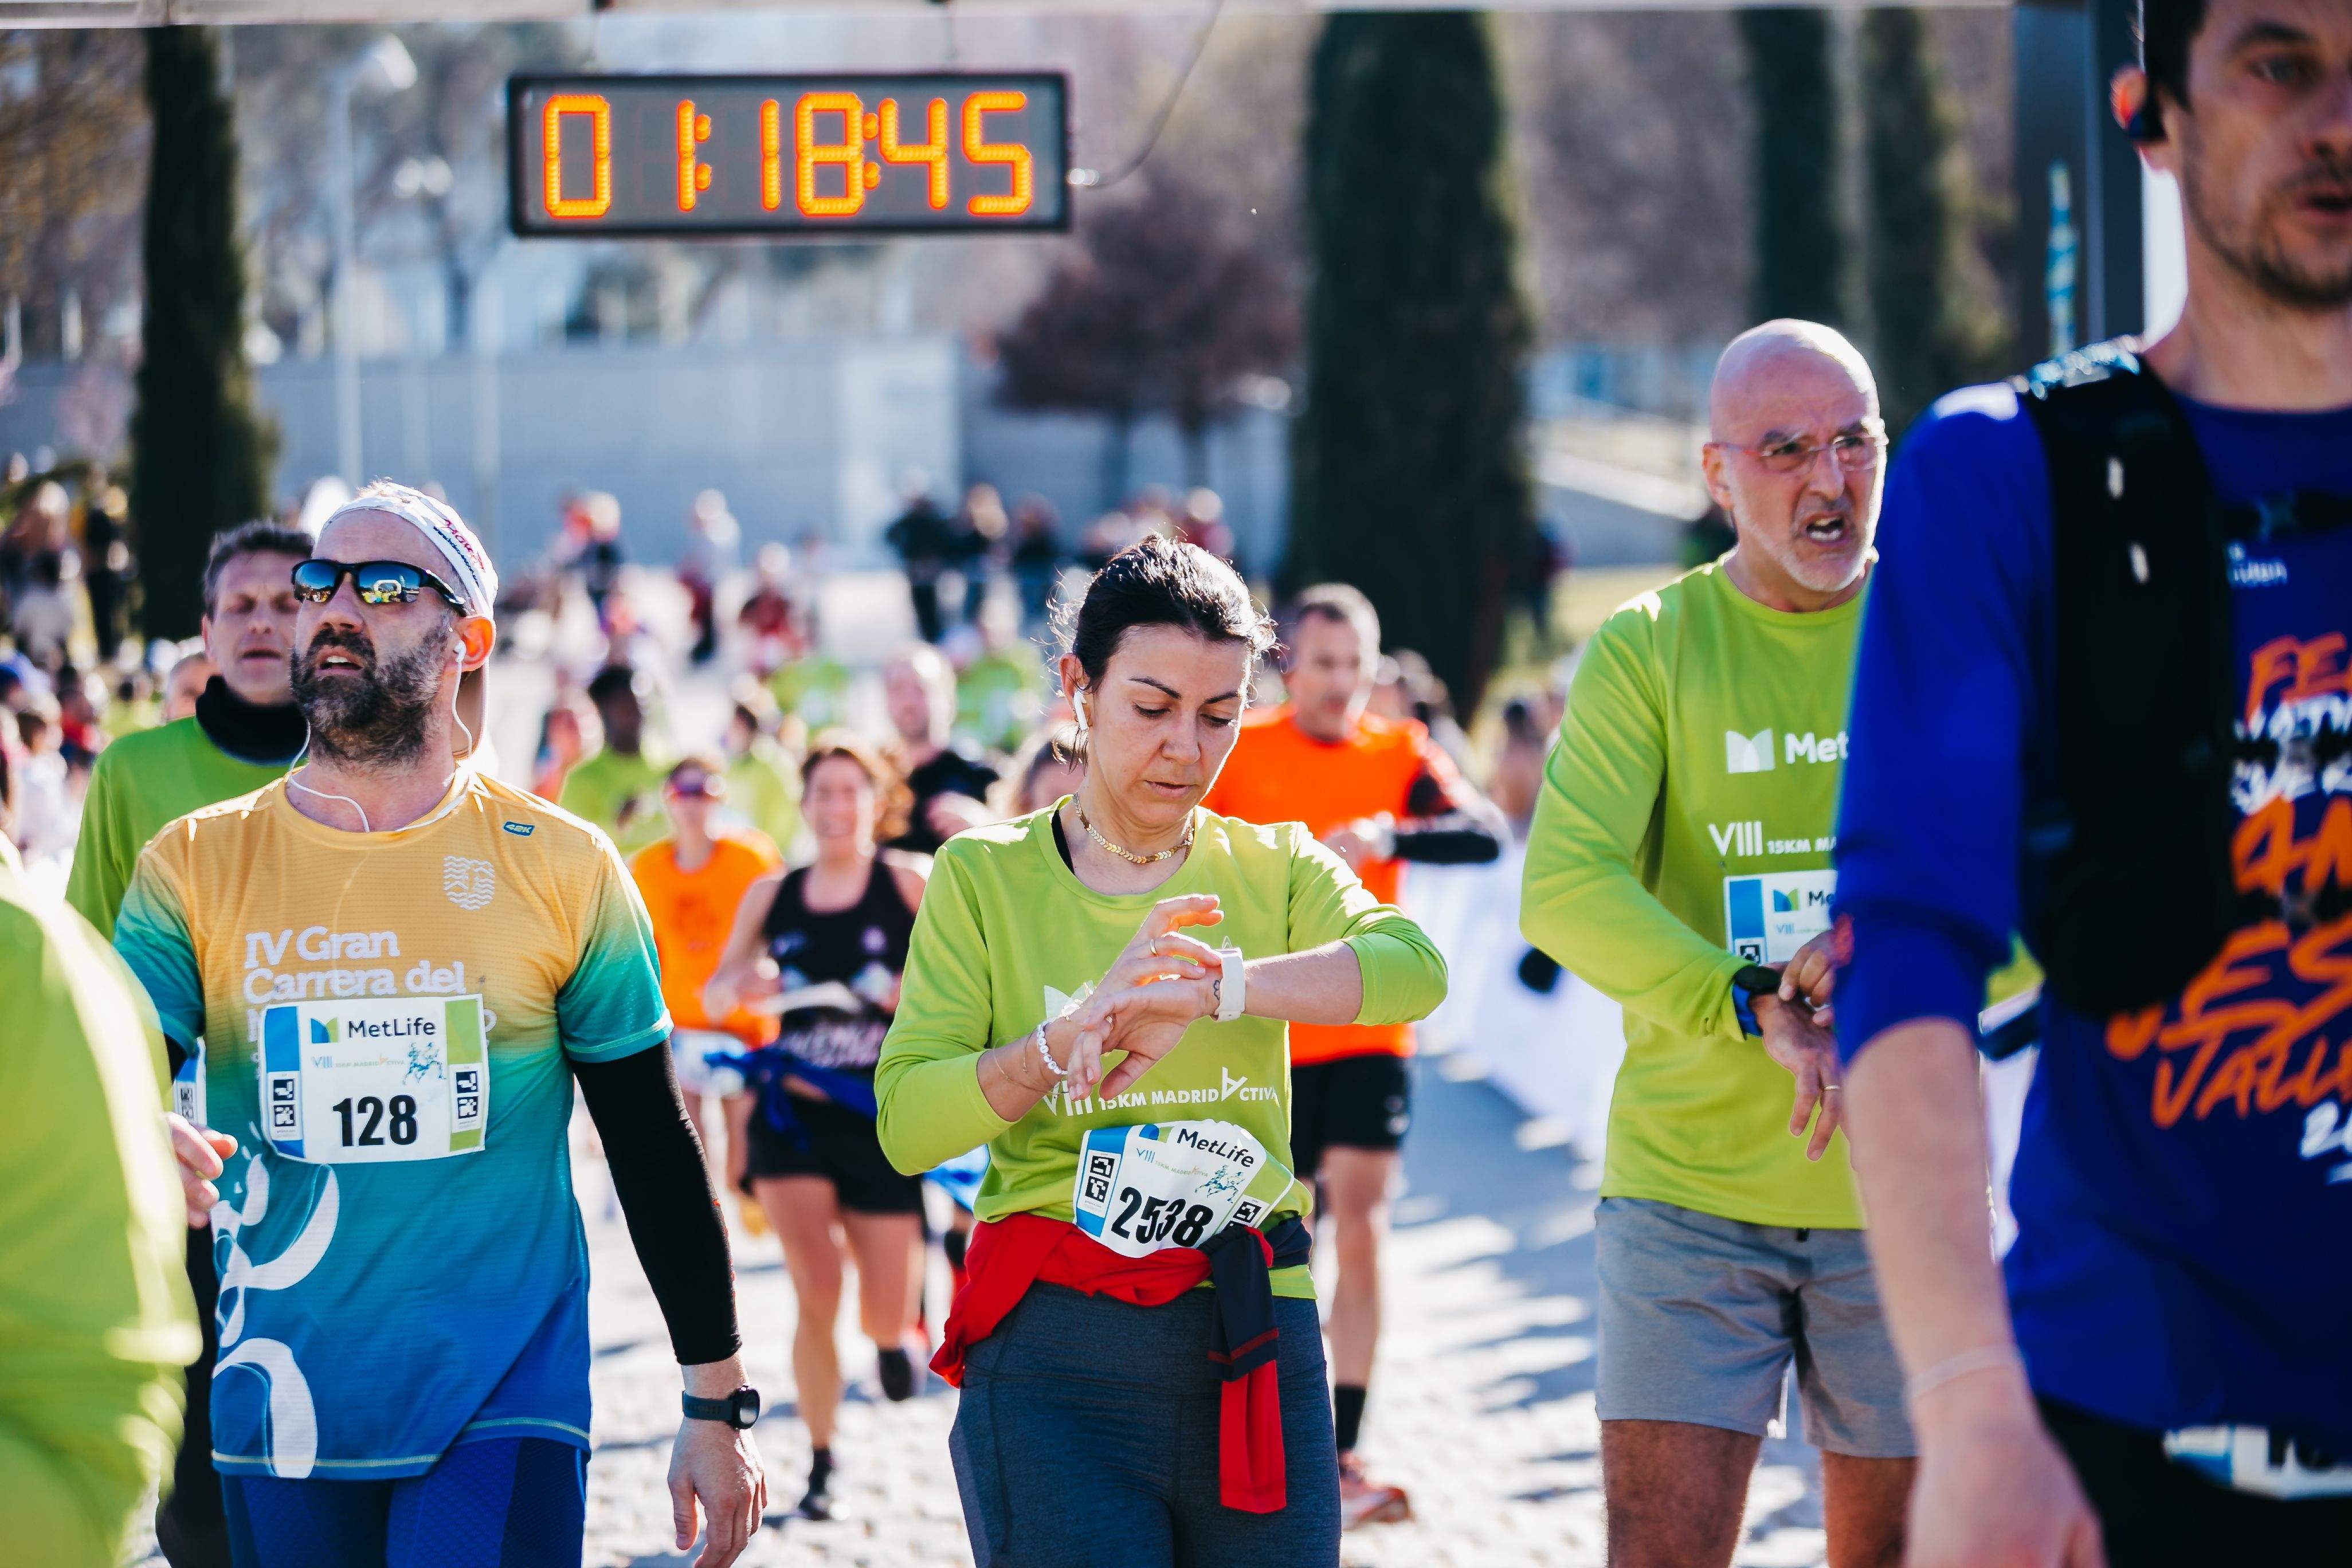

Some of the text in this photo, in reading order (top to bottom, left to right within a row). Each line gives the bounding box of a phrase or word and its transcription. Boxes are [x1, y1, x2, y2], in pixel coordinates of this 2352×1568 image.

[2245, 630, 2352, 736] FE
[1708, 821, 1763, 856] VIII
[1767, 838, 1811, 854] 15KM
[244, 926, 400, 969] IV Gran
[243, 960, 465, 1004] Carrera del
[348, 1017, 436, 1038] MetLife
[312, 1056, 332, 1068] VIII
[2150, 1032, 2352, 1129] VALL
[332, 1095, 418, 1147] 128
[1098, 1092, 1147, 1111] 15KM
[1136, 1147, 1155, 1163] VIII
[1177, 1128, 1255, 1167] MetLife
[1111, 1186, 1214, 1247] 2538
